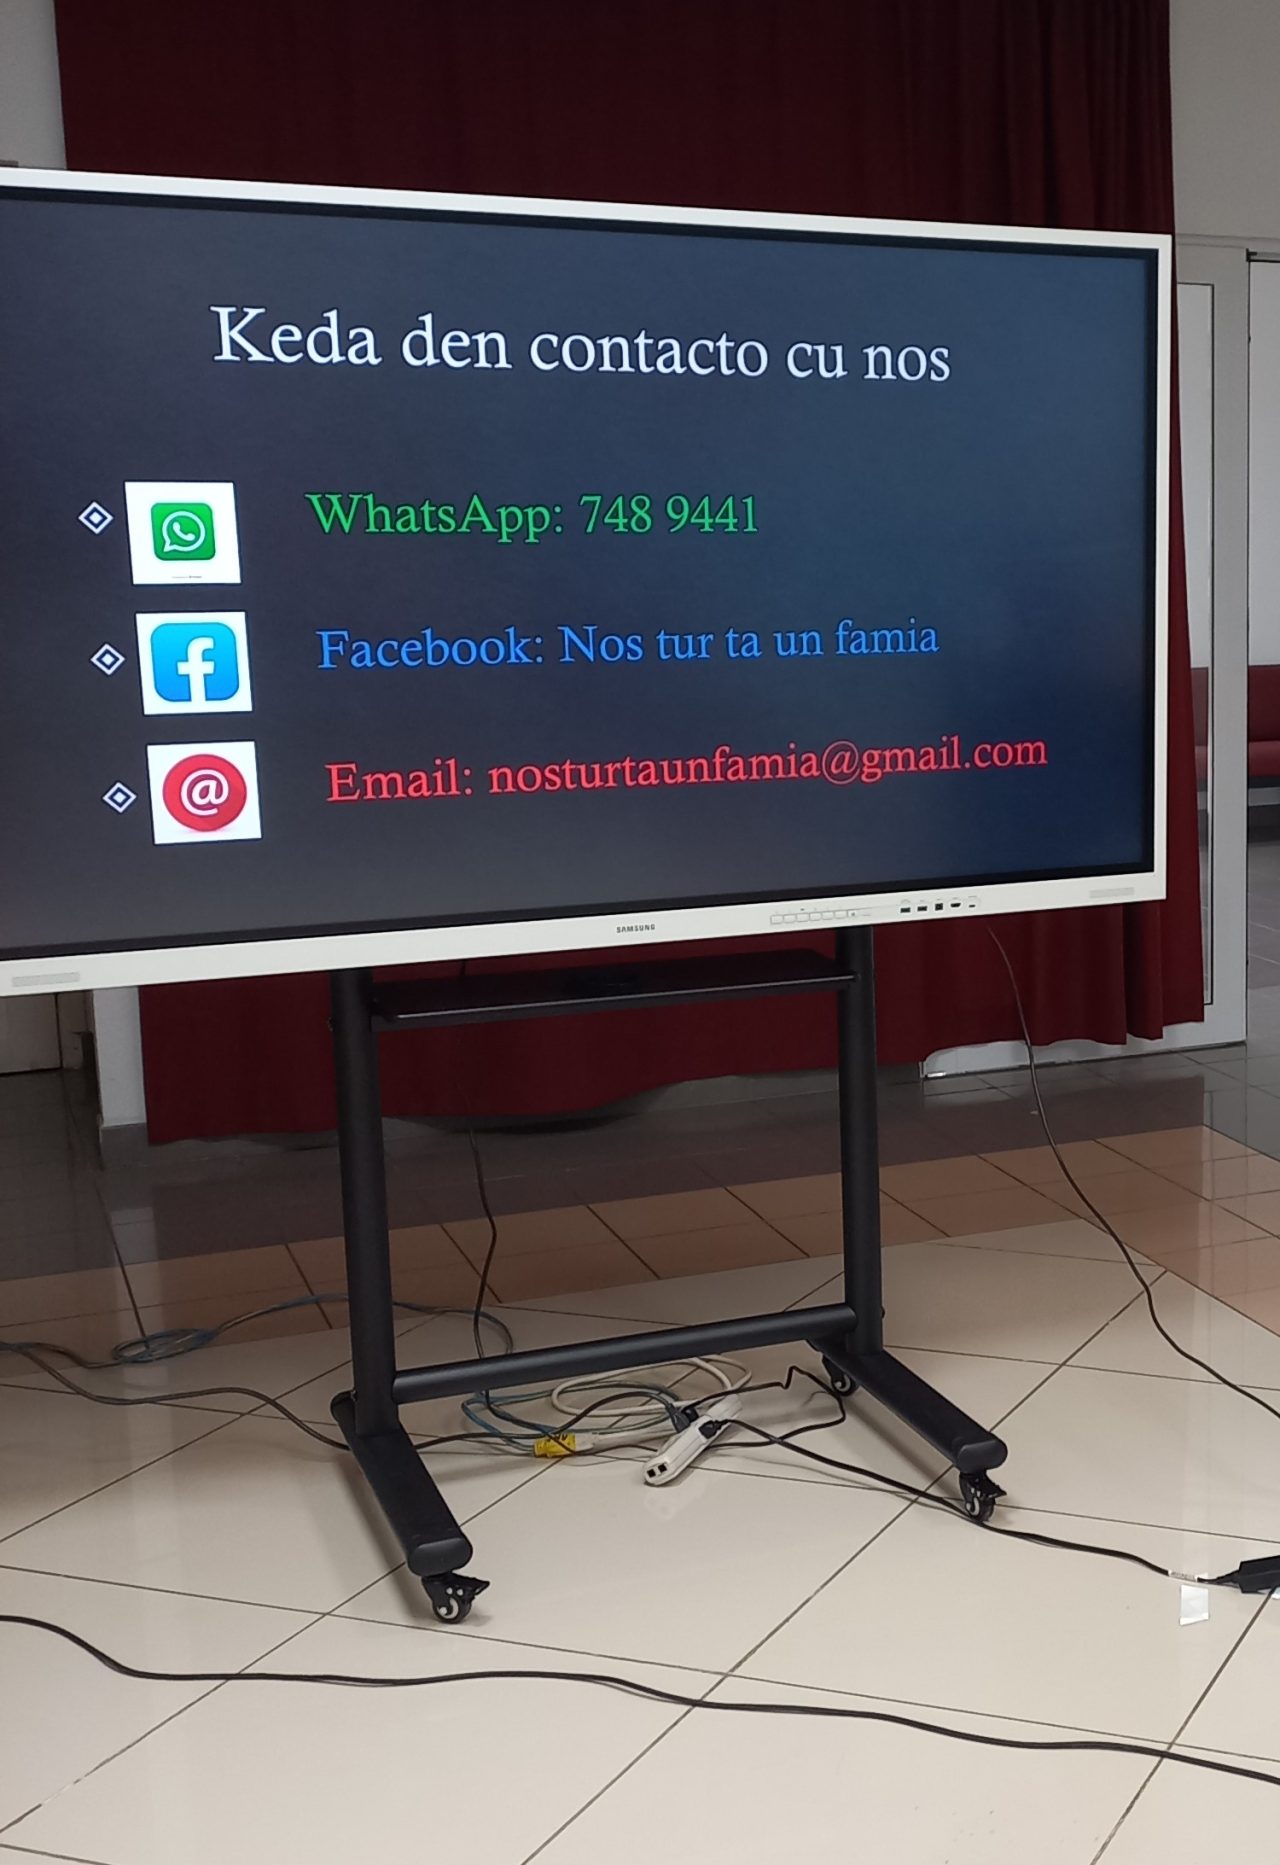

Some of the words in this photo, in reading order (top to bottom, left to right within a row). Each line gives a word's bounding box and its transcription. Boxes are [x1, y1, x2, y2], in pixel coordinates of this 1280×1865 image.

[211, 307, 382, 365] Keda
[403, 313, 512, 368] den
[531, 330, 767, 376] contacto
[788, 343, 847, 378] cu
[863, 346, 949, 381] nos
[306, 494, 561, 542] WhatsApp:
[581, 496, 651, 532] 748
[667, 496, 757, 532] 9441
[317, 627, 542, 668] Facebook:
[559, 626, 643, 661] Nos
[657, 631, 713, 659] tur
[726, 629, 762, 657] ta
[774, 632, 823, 656] un
[836, 619, 939, 654] famia
[326, 759, 471, 801] Email:
[489, 736, 1046, 792] nosturtaunfamia@gmail.com
[616, 923, 656, 934] SAMSUNG
